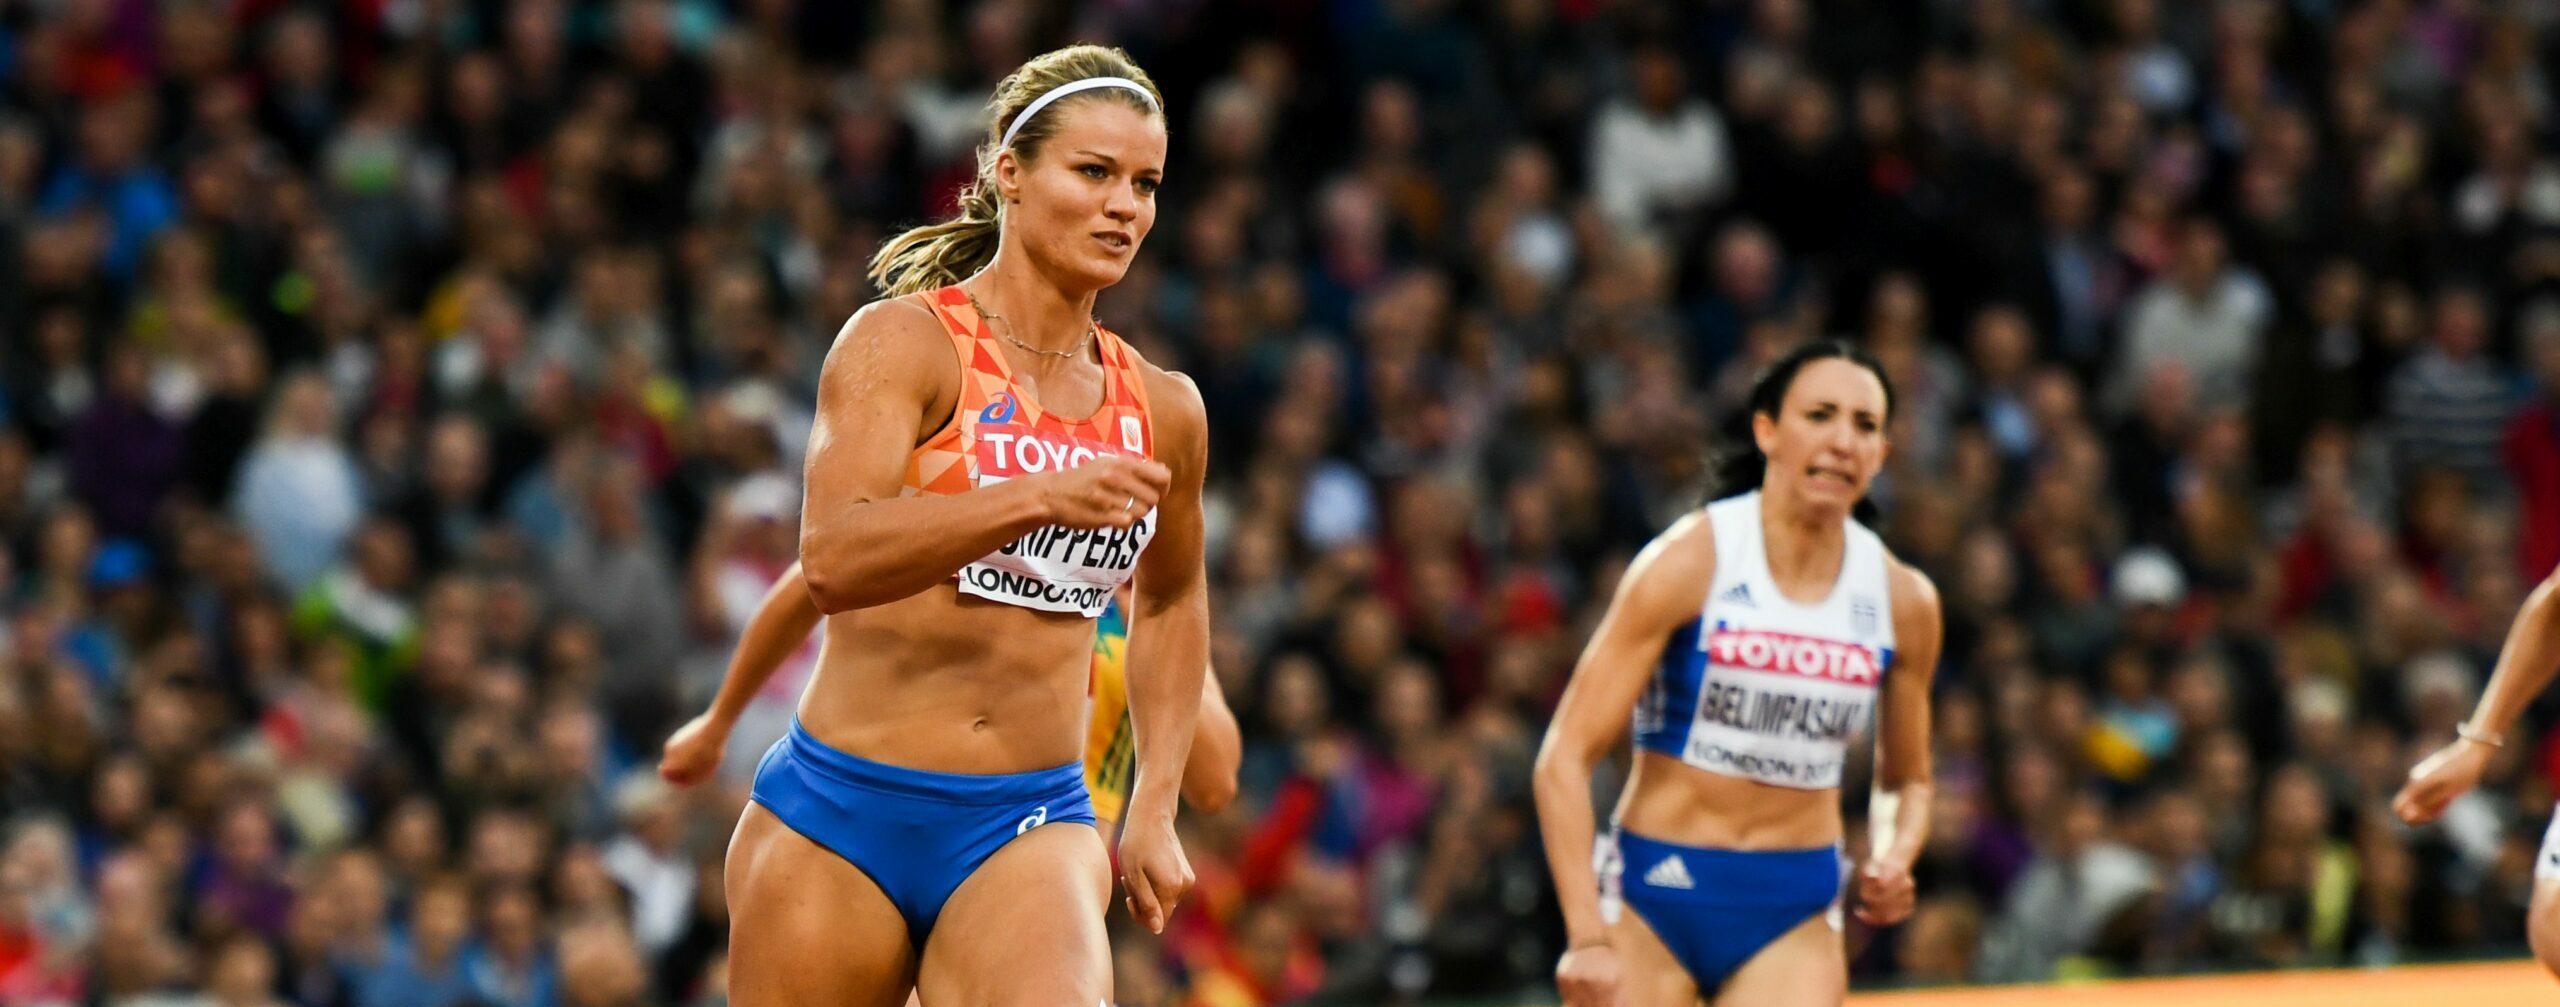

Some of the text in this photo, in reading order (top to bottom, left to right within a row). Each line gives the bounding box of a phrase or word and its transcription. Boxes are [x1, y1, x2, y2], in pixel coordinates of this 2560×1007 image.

[983, 433, 1119, 473] TOYO
[966, 566, 1070, 603] LONDO
[1714, 632, 1875, 682] TOYOTA
